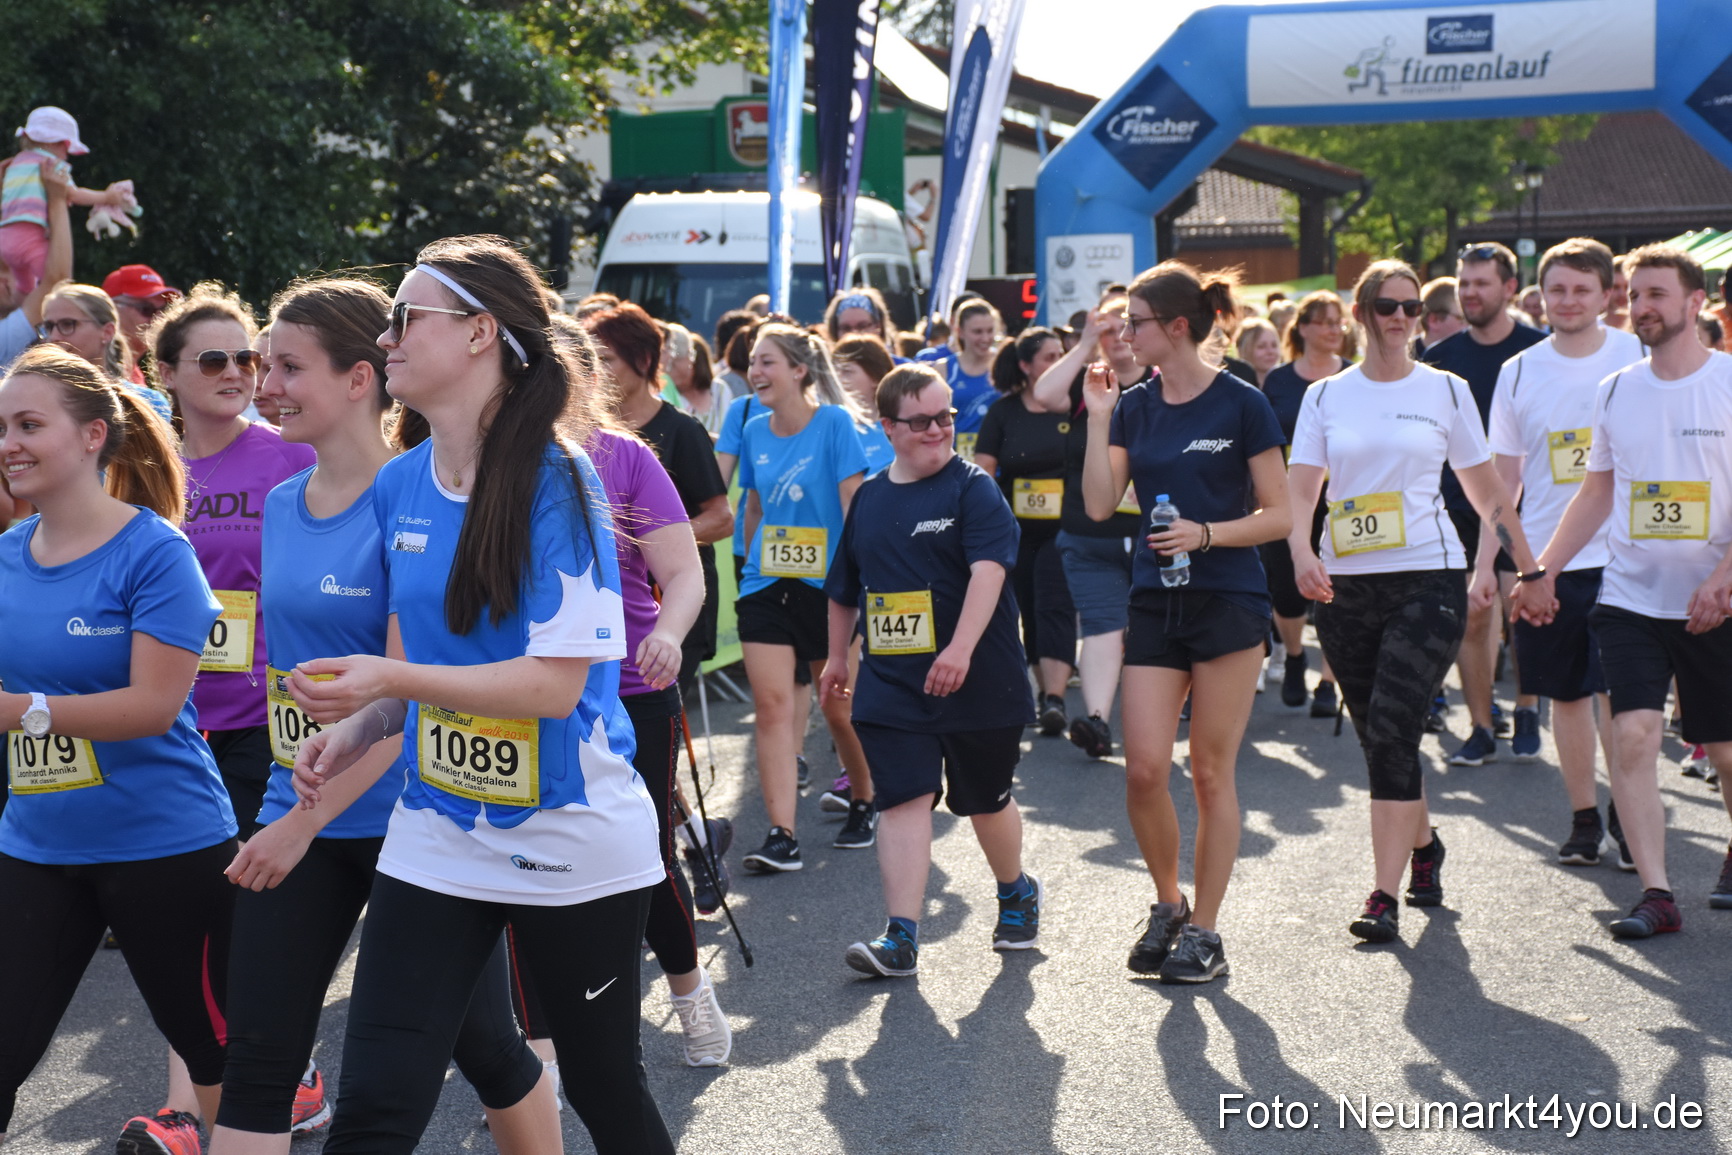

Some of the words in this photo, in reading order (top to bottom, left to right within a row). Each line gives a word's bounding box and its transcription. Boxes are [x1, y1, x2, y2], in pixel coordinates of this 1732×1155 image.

[1402, 50, 1552, 84] firmenlauf
[1119, 115, 1200, 137] Fischer
[1396, 413, 1438, 427] auctores
[1682, 428, 1726, 438] auctores
[1182, 439, 1218, 454] JURA
[1572, 446, 1591, 467] 2
[1027, 494, 1046, 507] 69
[1652, 502, 1682, 523] 33
[184, 525, 260, 536] REATIONEN
[911, 519, 941, 537] JURA
[1351, 514, 1378, 537] 30
[769, 544, 817, 564] 1533
[340, 586, 371, 597] classic
[91, 624, 125, 636] classic
[209, 619, 228, 648] 0
[873, 614, 921, 637] 1447
[202, 649, 228, 657] ristina
[275, 704, 322, 742] 108
[432, 704, 474, 727] firmenlauf
[478, 725, 502, 738] walk
[503, 730, 529, 741] 2019
[13, 733, 76, 768] 1079
[281, 741, 296, 752] Meier
[430, 724, 519, 777] 1089
[17, 768, 47, 778] Leonhardt
[48, 765, 78, 776] Annika
[431, 759, 461, 778] Winkler
[463, 771, 517, 789] Magdalena
[452, 778, 464, 787] IKK
[464, 782, 487, 793] classic
[537, 862, 573, 873] classic
